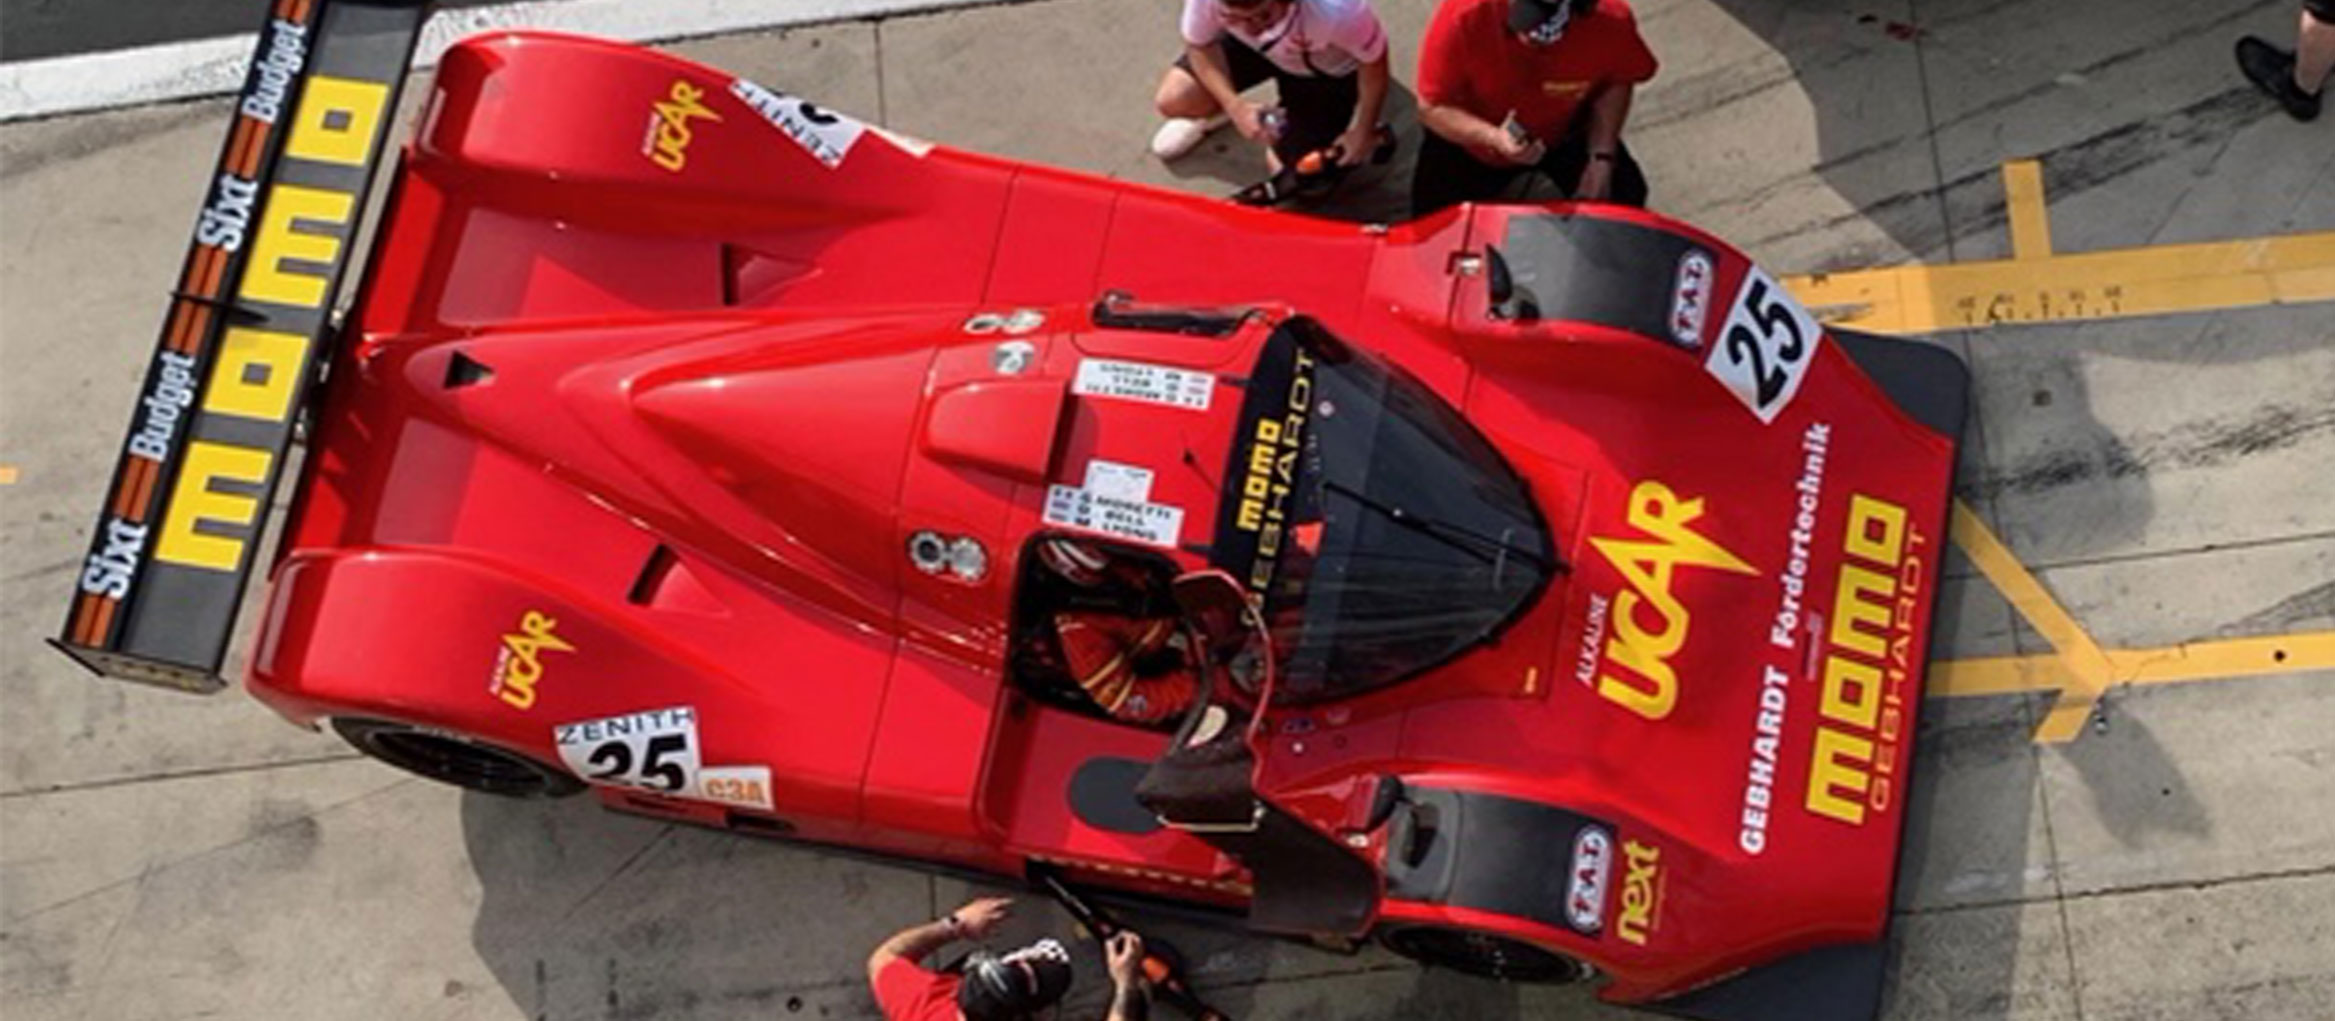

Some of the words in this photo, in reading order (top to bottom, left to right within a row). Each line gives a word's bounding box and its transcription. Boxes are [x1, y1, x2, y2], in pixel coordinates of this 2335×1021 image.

[198, 174, 258, 252] Sixt
[241, 20, 307, 123] Budget
[652, 81, 723, 172] UCAR
[1726, 278, 1804, 409] 25
[83, 518, 148, 600] Sixt
[130, 351, 195, 462] Budget
[501, 610, 576, 710] UCAR
[1587, 480, 1763, 721] UCAR
[557, 708, 694, 745] ZENITH
[1870, 522, 1926, 812] GEBHARDT
[588, 734, 687, 793] 25
[1740, 665, 1789, 855] GEBHARDT
[1617, 840, 1660, 946] next
